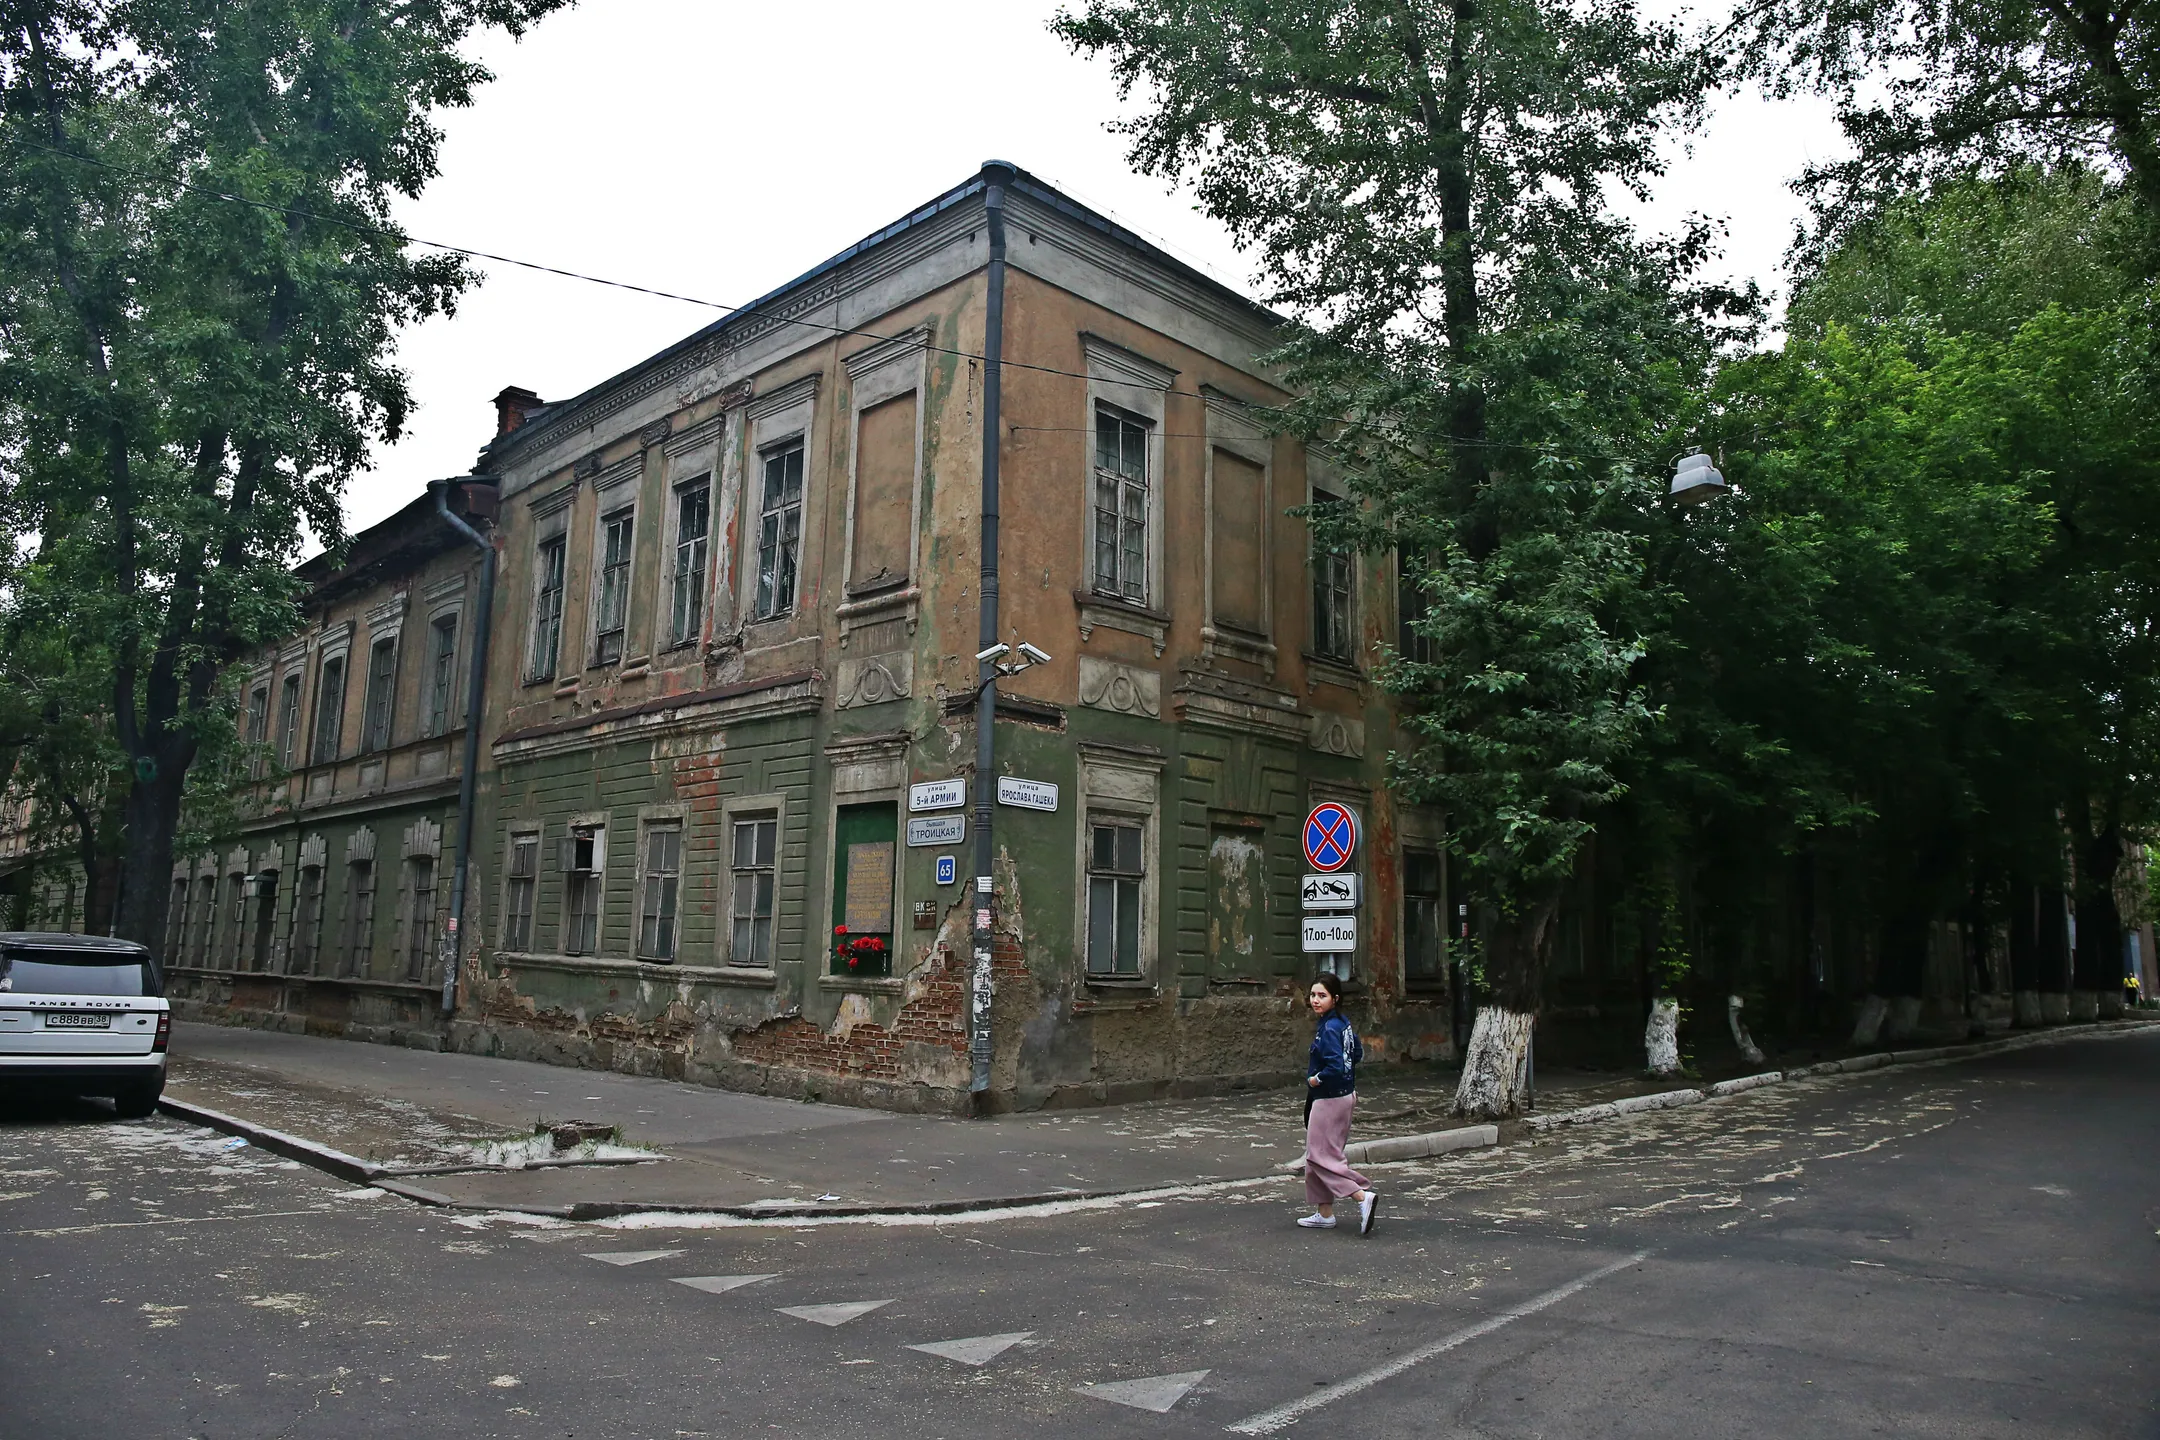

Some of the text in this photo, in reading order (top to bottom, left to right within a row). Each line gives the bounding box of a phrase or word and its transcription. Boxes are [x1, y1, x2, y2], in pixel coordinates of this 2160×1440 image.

[927, 785, 947, 793] улица
[916, 792, 957, 806] 5-й АРМИИ
[1001, 789, 1054, 805] ЯРОСЛАВА ГАШЕКА
[915, 827, 955, 839] ТРОИЦКАЯ
[940, 864, 951, 877] 65
[95, 1015, 107, 1023] 38
